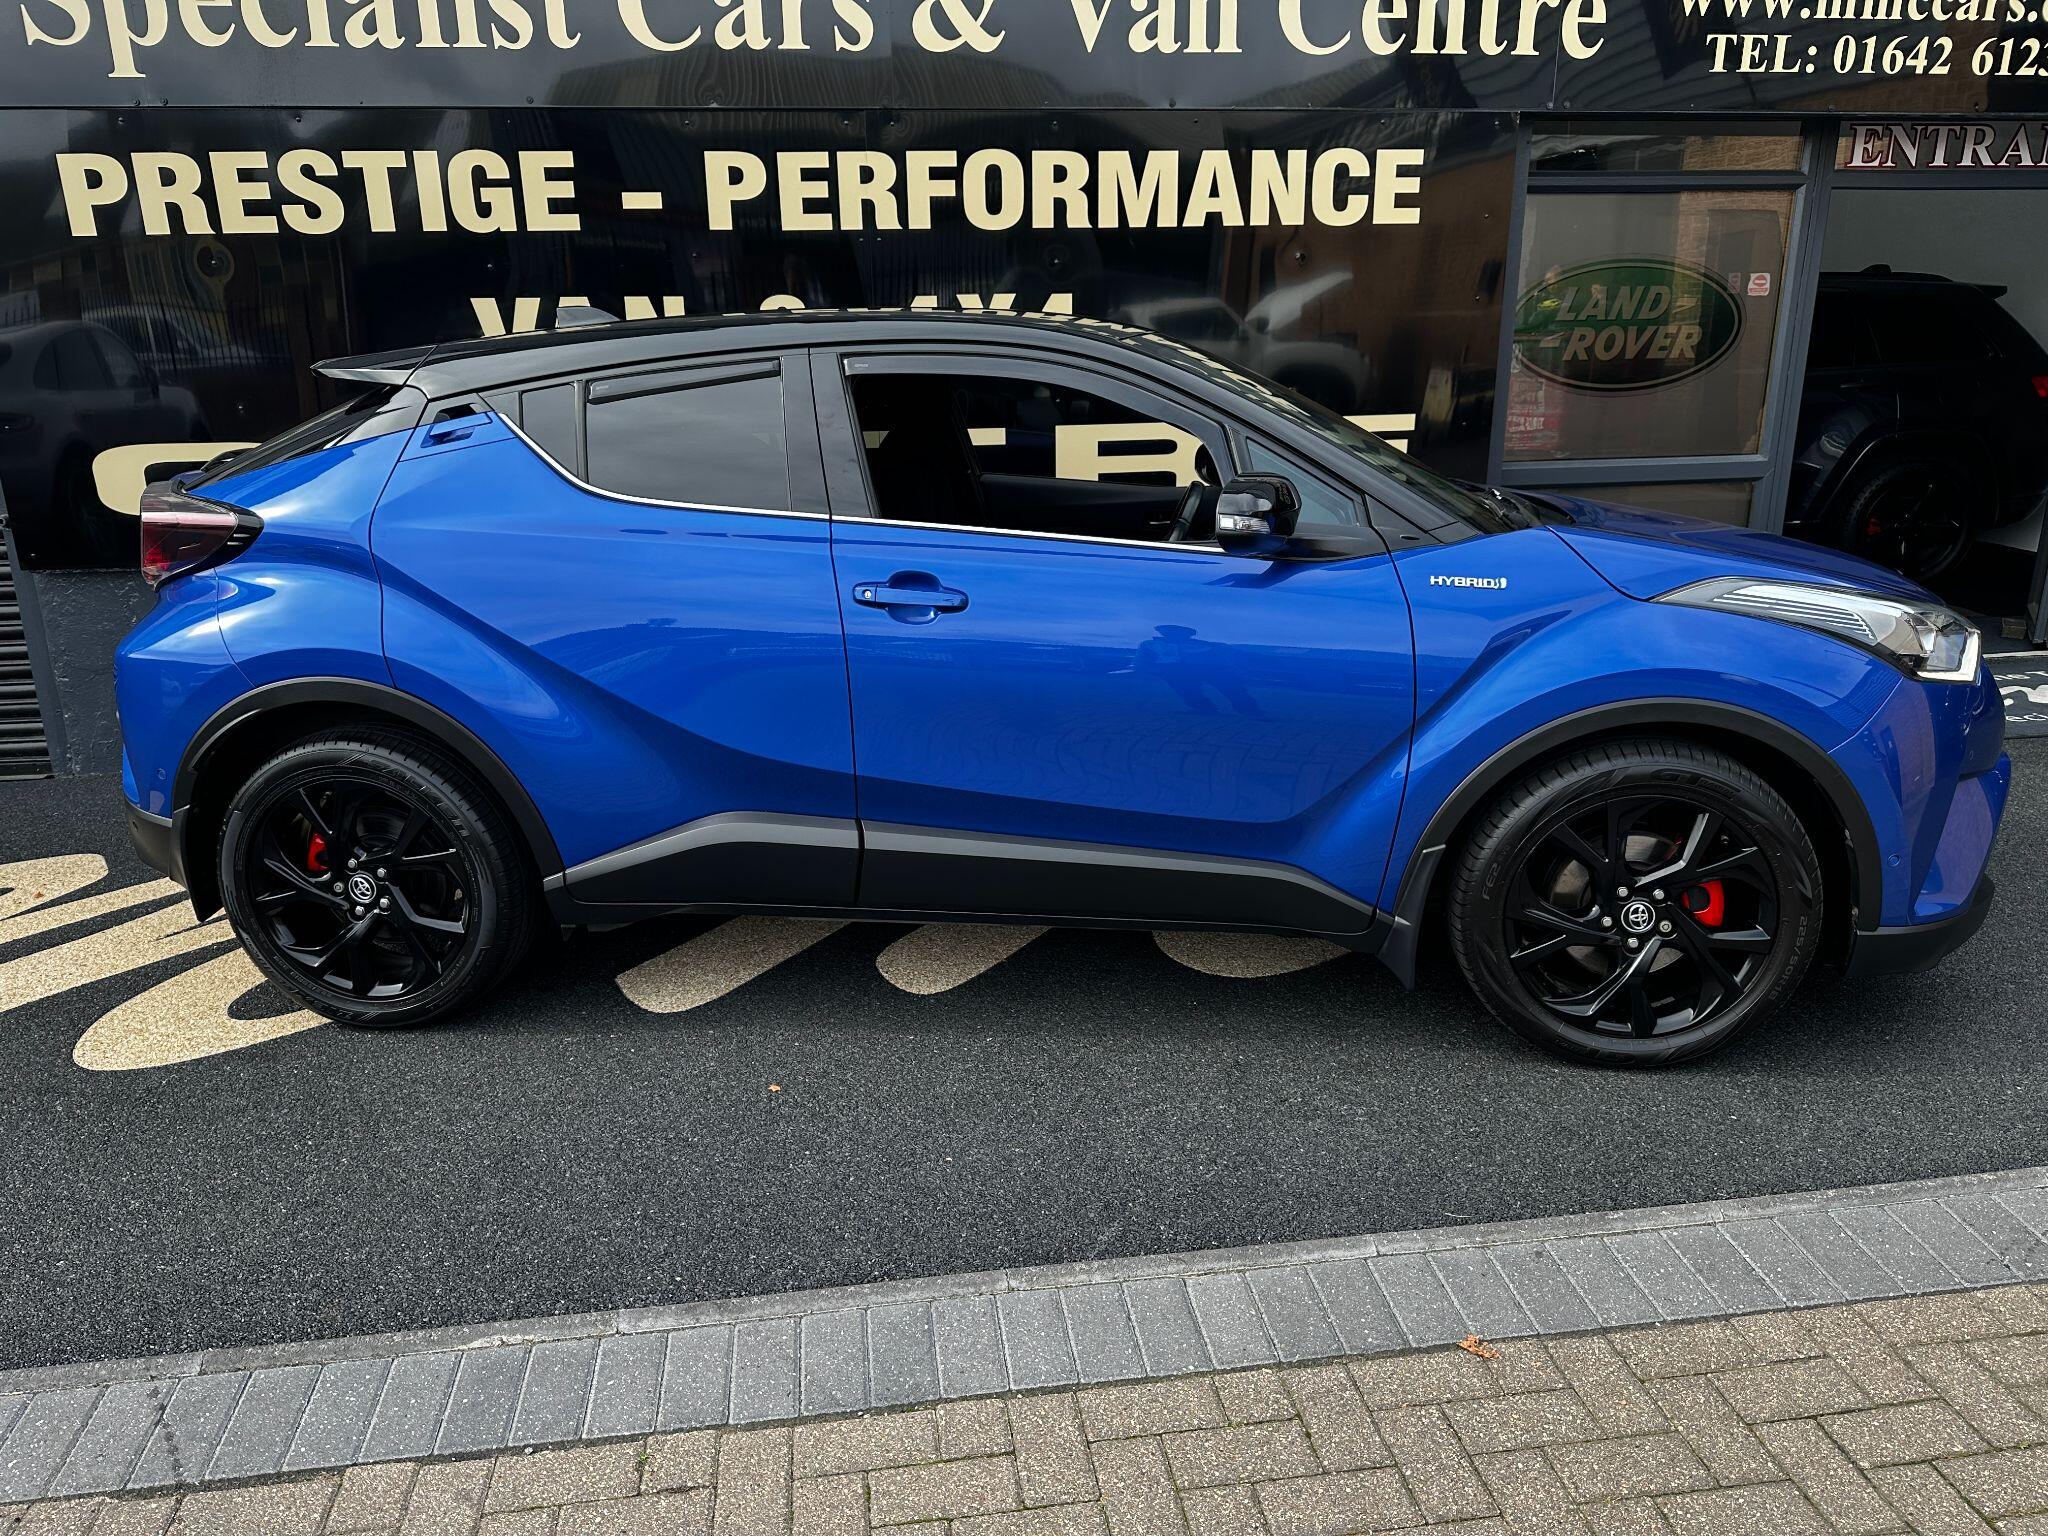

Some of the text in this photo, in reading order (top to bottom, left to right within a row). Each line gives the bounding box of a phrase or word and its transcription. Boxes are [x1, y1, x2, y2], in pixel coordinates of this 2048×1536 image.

[1681, 0, 2048, 22] www.mmccars.
[911, 0, 1006, 53] &
[1278, 0, 1608, 60] Centre
[1706, 34, 1818, 74] TEL:
[1833, 35, 1953, 75] 01642
[56, 148, 582, 237] PRESTIGE
[703, 147, 1425, 231] PERFORMANCE
[1555, 285, 1674, 322] LAND
[1561, 325, 1704, 361] ROVER
[1429, 575, 1496, 589] HYBRID
